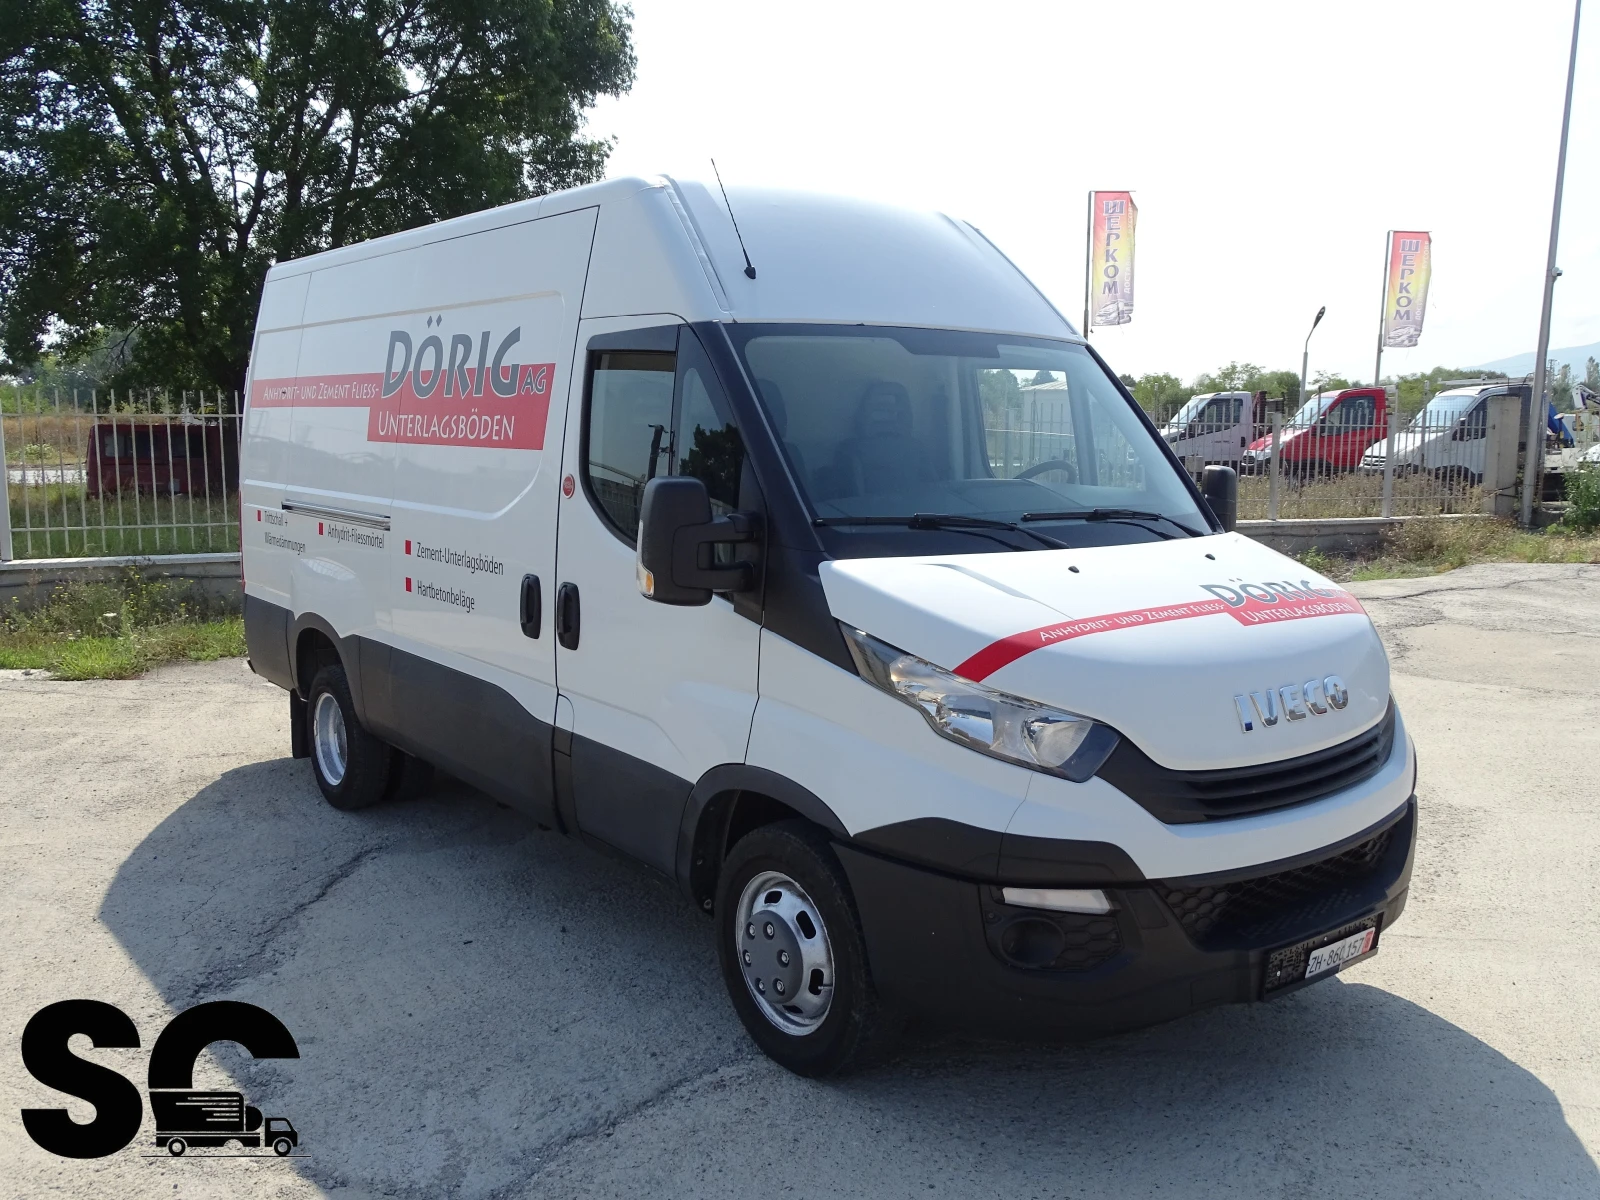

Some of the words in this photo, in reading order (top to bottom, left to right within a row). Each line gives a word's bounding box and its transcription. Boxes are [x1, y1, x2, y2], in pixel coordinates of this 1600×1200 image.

[1103, 200, 1125, 295] ШЕРКОМ
[1394, 239, 1421, 321] ШЕРКОМ
[381, 314, 521, 399] DÖRIG
[520, 367, 547, 395] AG
[301, 386, 317, 400] UND
[318, 382, 350, 399] ZEMENT
[352, 381, 379, 399] FLIESS-
[378, 409, 515, 440] UNTERLAGSBÖDEN
[416, 541, 504, 576] Zement-Unterlagsböden
[416, 580, 475, 613] Hartbetonbeläge
[1199, 577, 1334, 608] DÖRIG
[1039, 620, 1113, 642] ANHYDRIT-
[1113, 614, 1144, 625] UND
[1143, 607, 1191, 621] ZEMENT
[1240, 601, 1356, 623] UNTERLAGSBÖDEN
[1234, 674, 1350, 734] IVECO
